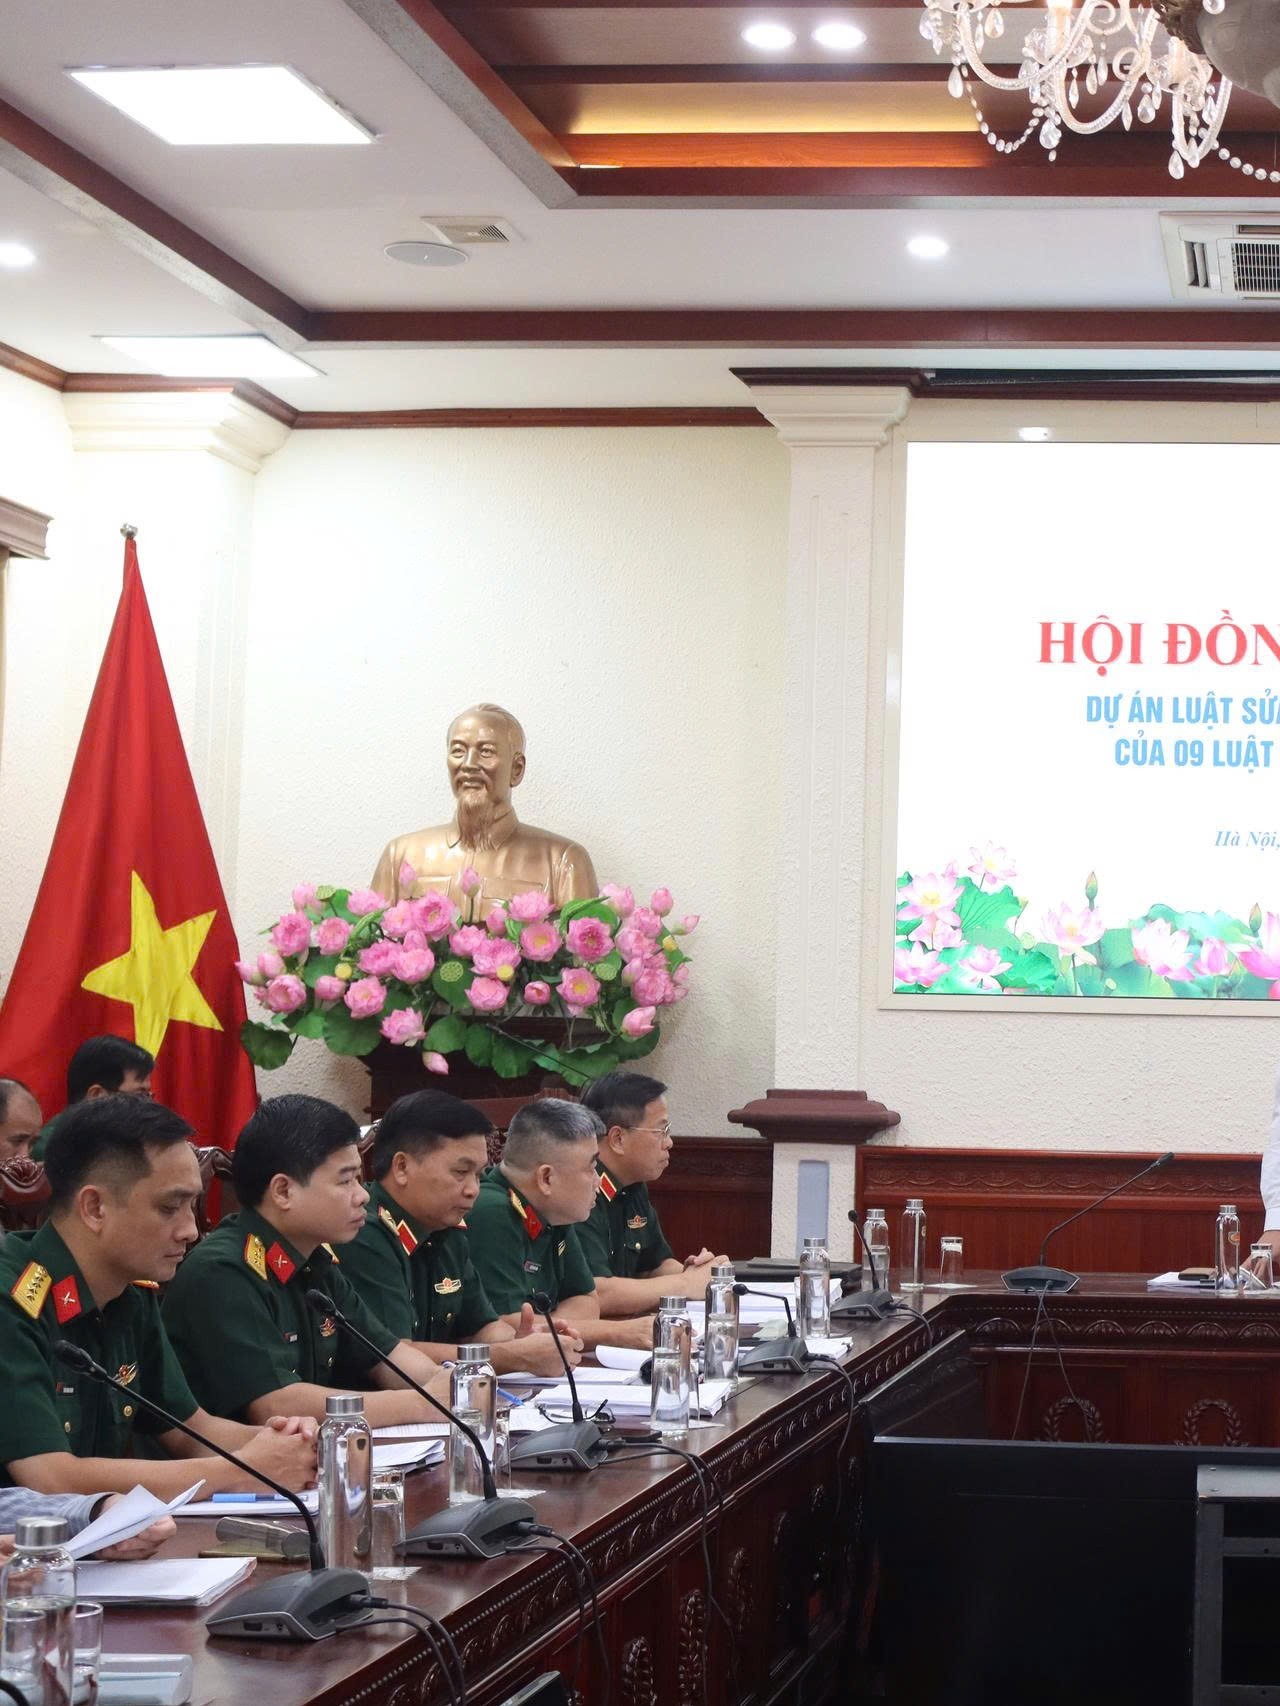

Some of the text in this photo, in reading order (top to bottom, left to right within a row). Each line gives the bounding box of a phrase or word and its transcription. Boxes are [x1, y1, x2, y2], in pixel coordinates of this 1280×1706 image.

[1038, 615, 1144, 677] HỘI
[1087, 693, 1123, 729] DỰ
[1128, 691, 1163, 723] ÁN
[1172, 690, 1233, 730] LUẬT
[1114, 730, 1165, 767] CỦA
[1174, 740, 1204, 768] 09
[1213, 735, 1274, 773] LUẬT
[1214, 830, 1240, 847] Hà
[1246, 831, 1280, 851] Nội,
